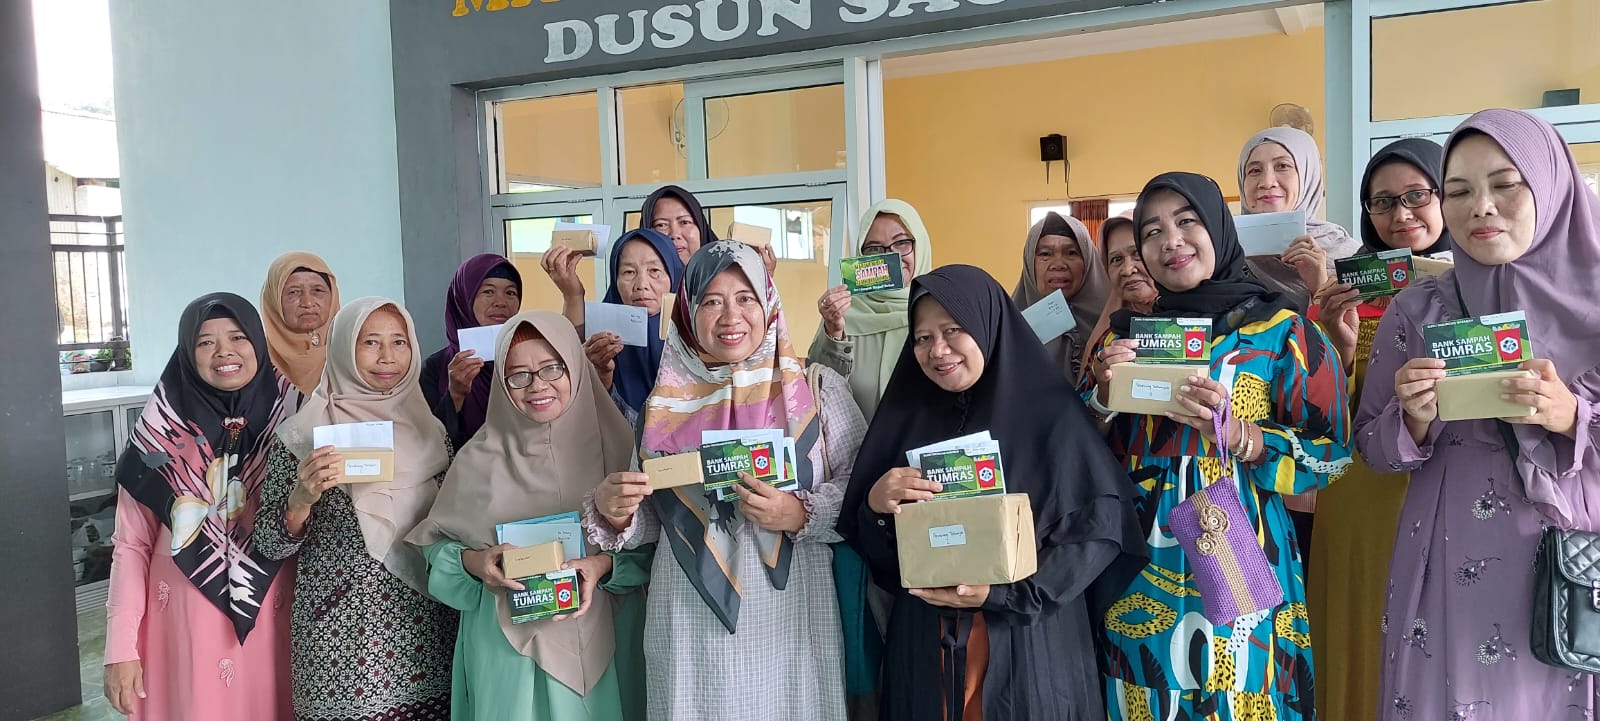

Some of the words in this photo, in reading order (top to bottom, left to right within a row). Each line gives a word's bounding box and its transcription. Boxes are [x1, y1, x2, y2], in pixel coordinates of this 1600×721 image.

[544, 0, 811, 63] DUSUN
[856, 264, 889, 280] SAMPAH
[1342, 273, 1388, 285] TUMRAS
[1432, 340, 1454, 348] BANK
[1456, 335, 1490, 345] SAMPAH
[1432, 342, 1493, 358] TUMRAS
[724, 454, 748, 462] SAMPAH
[706, 459, 750, 473] TUMRAS
[927, 471, 974, 483] TUMRAS
[513, 593, 554, 606] TUMRAS
